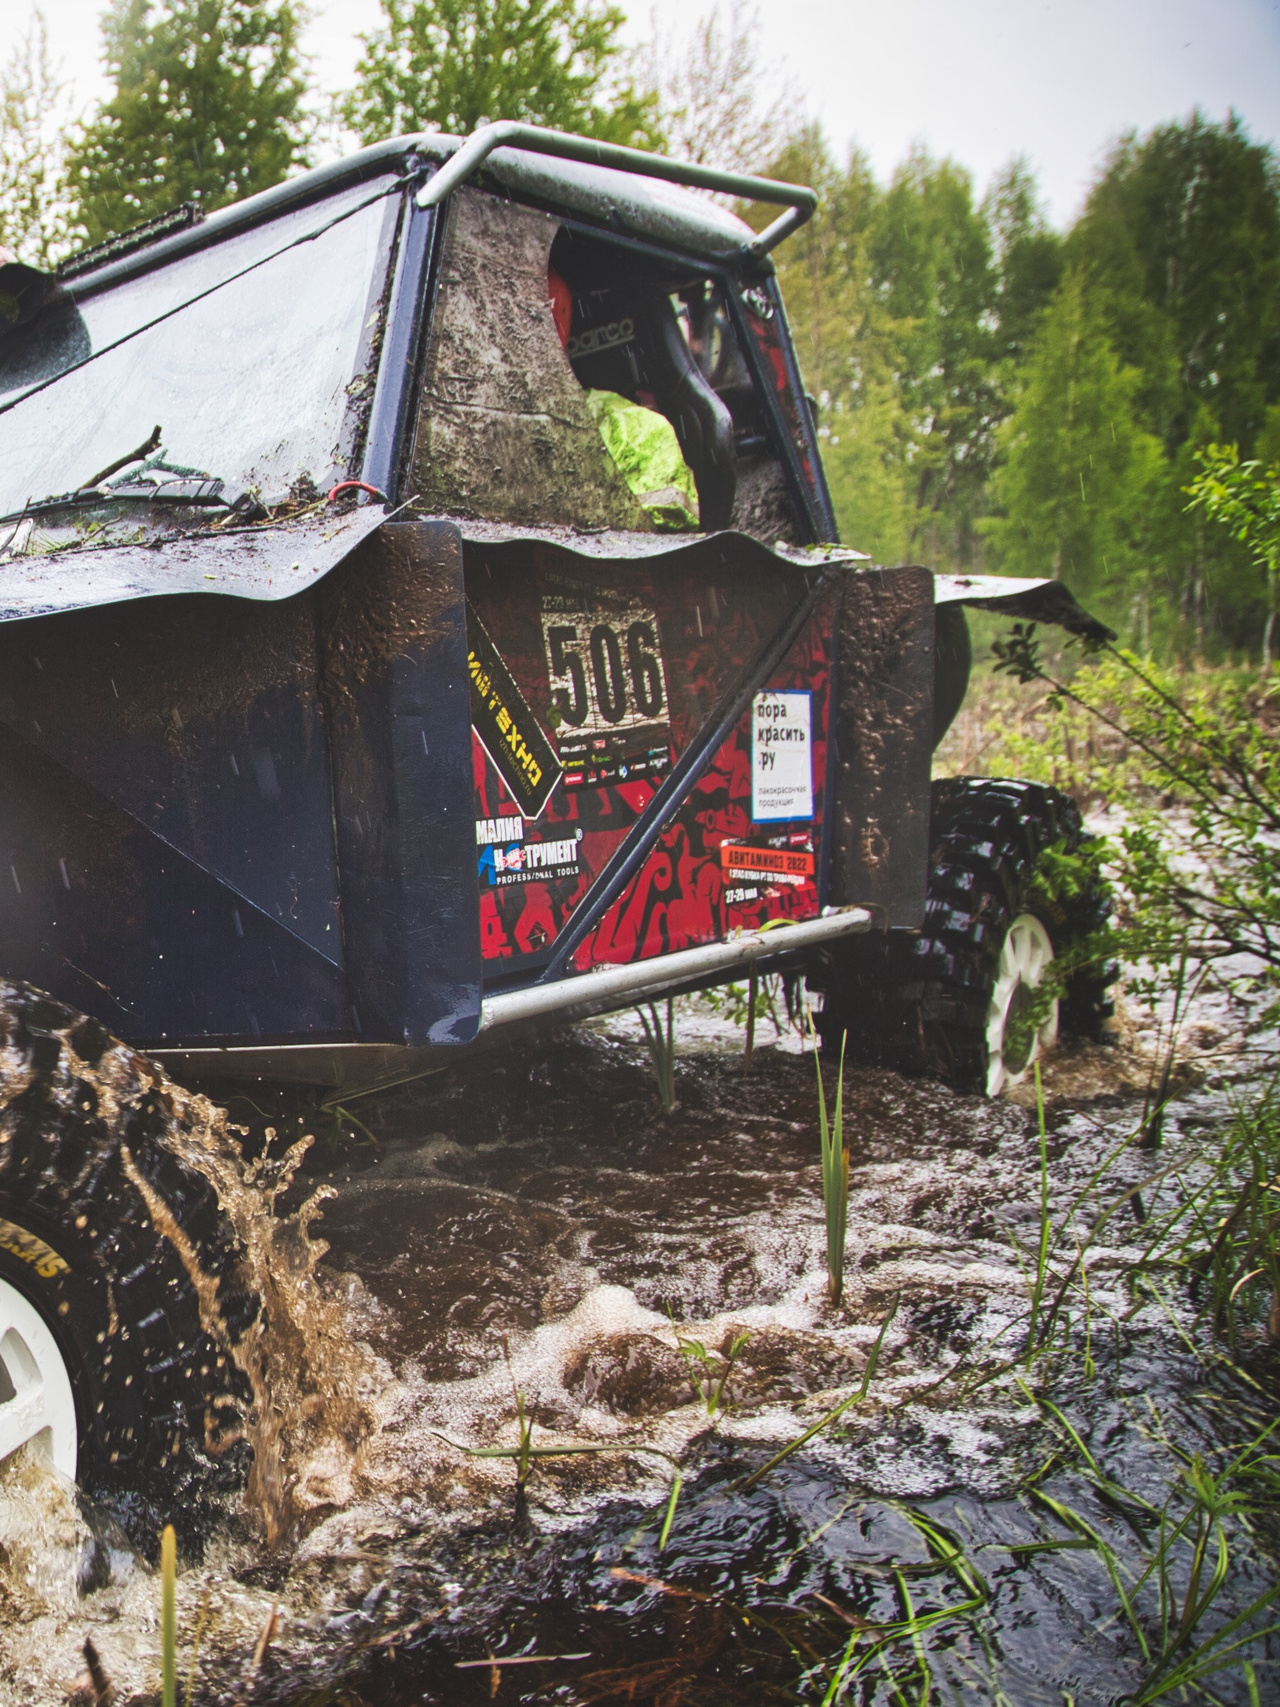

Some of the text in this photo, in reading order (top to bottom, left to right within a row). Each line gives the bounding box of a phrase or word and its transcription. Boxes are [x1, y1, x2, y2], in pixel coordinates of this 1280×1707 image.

[567, 317, 634, 355] parco
[547, 621, 663, 727] 506
[757, 703, 787, 722] пора
[757, 727, 805, 747] красить
[557, 866, 579, 877] TOOLS
[725, 887, 745, 904] 27-29
